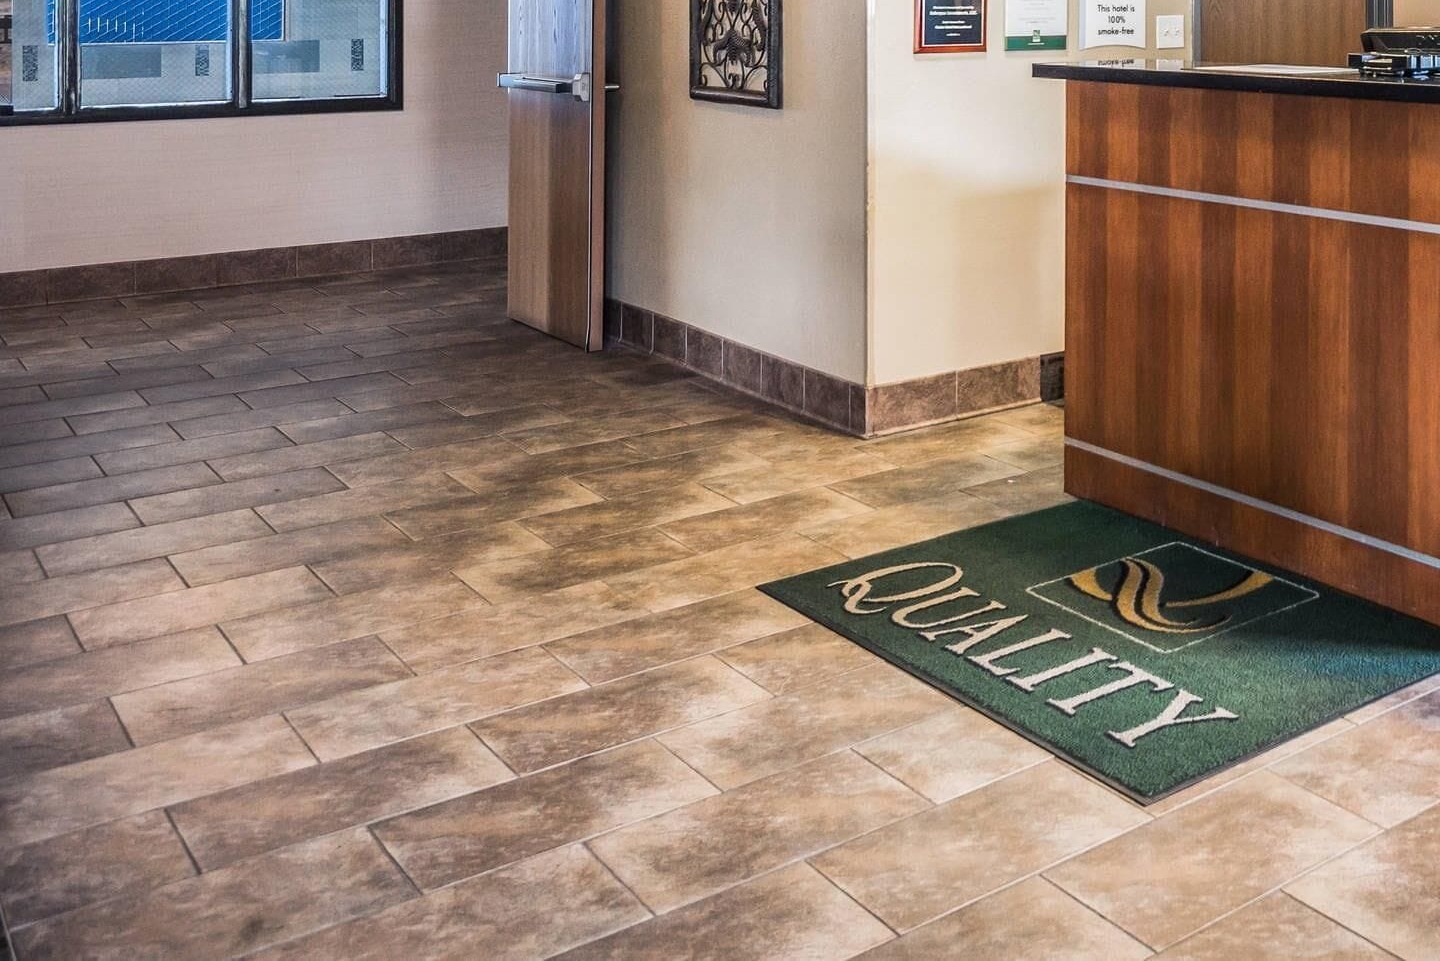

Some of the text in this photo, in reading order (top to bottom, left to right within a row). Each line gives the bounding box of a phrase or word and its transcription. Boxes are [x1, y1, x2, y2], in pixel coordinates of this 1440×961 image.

[1097, 4, 1111, 12] This
[1112, 4, 1129, 12] hotel
[1108, 15, 1126, 24] 100%
[1097, 26, 1134, 35] smoke-free
[826, 561, 1239, 749] QUALITY
